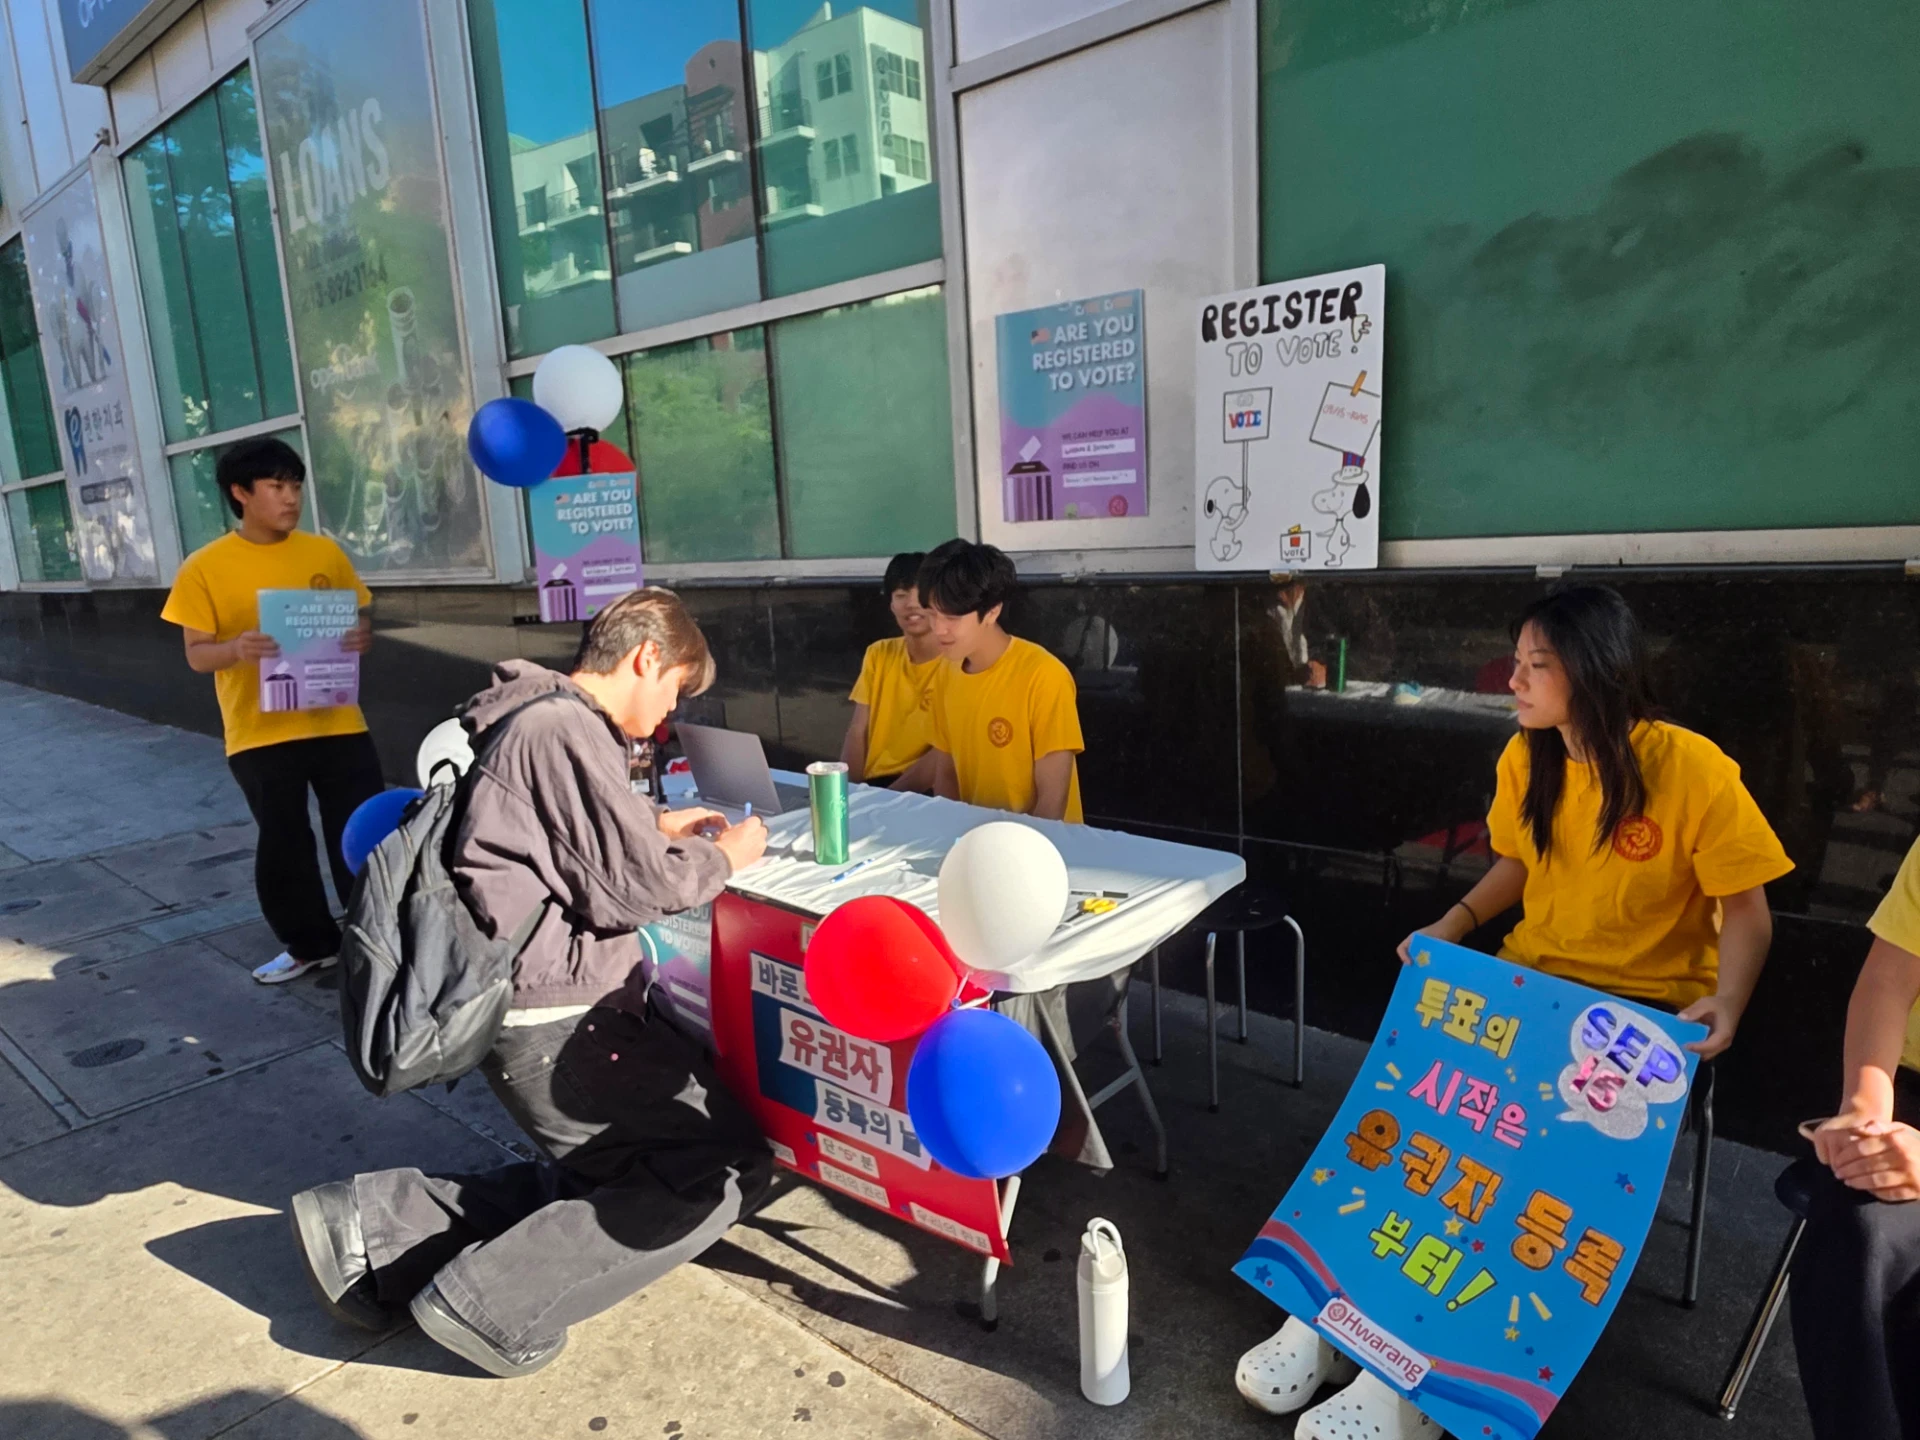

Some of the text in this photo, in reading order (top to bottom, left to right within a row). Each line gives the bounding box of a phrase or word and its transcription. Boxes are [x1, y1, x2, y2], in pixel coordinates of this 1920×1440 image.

[280, 98, 390, 234] LOANS
[1054, 313, 1135, 345] ARE YOU
[1202, 281, 1363, 343] REGISTER
[1032, 339, 1135, 371] REGISTERED
[1225, 341, 1263, 377] TO
[1048, 362, 1135, 390] TO VOTE?
[557, 503, 632, 521] REGISTERED
[572, 489, 631, 504] ARE YOU
[570, 517, 634, 534] TO VOTE?
[1284, 548, 1305, 557] VOTE
[286, 615, 355, 626] REGISTERED
[301, 604, 354, 614] ARE YOU
[297, 627, 313, 638] TO
[657, 927, 673, 944] TO
[758, 960, 800, 1000] 바로
[1415, 978, 1521, 1060] 투표의
[789, 1019, 884, 1094] 유권자
[1581, 1007, 1682, 1088] SEP
[1569, 1054, 1627, 1113] 15
[824, 1088, 892, 1145] 등록의
[1407, 1060, 1528, 1150] 시작은
[823, 1137, 836, 1155] 단
[861, 1154, 874, 1172] 분
[823, 1165, 888, 1205] 우리의 권리
[916, 1209, 957, 1236] 우리의
[1344, 1109, 1627, 1307] 유권자 등록
[1368, 1209, 1498, 1313] 부터!
[1342, 1312, 1424, 1384] Hwarang
